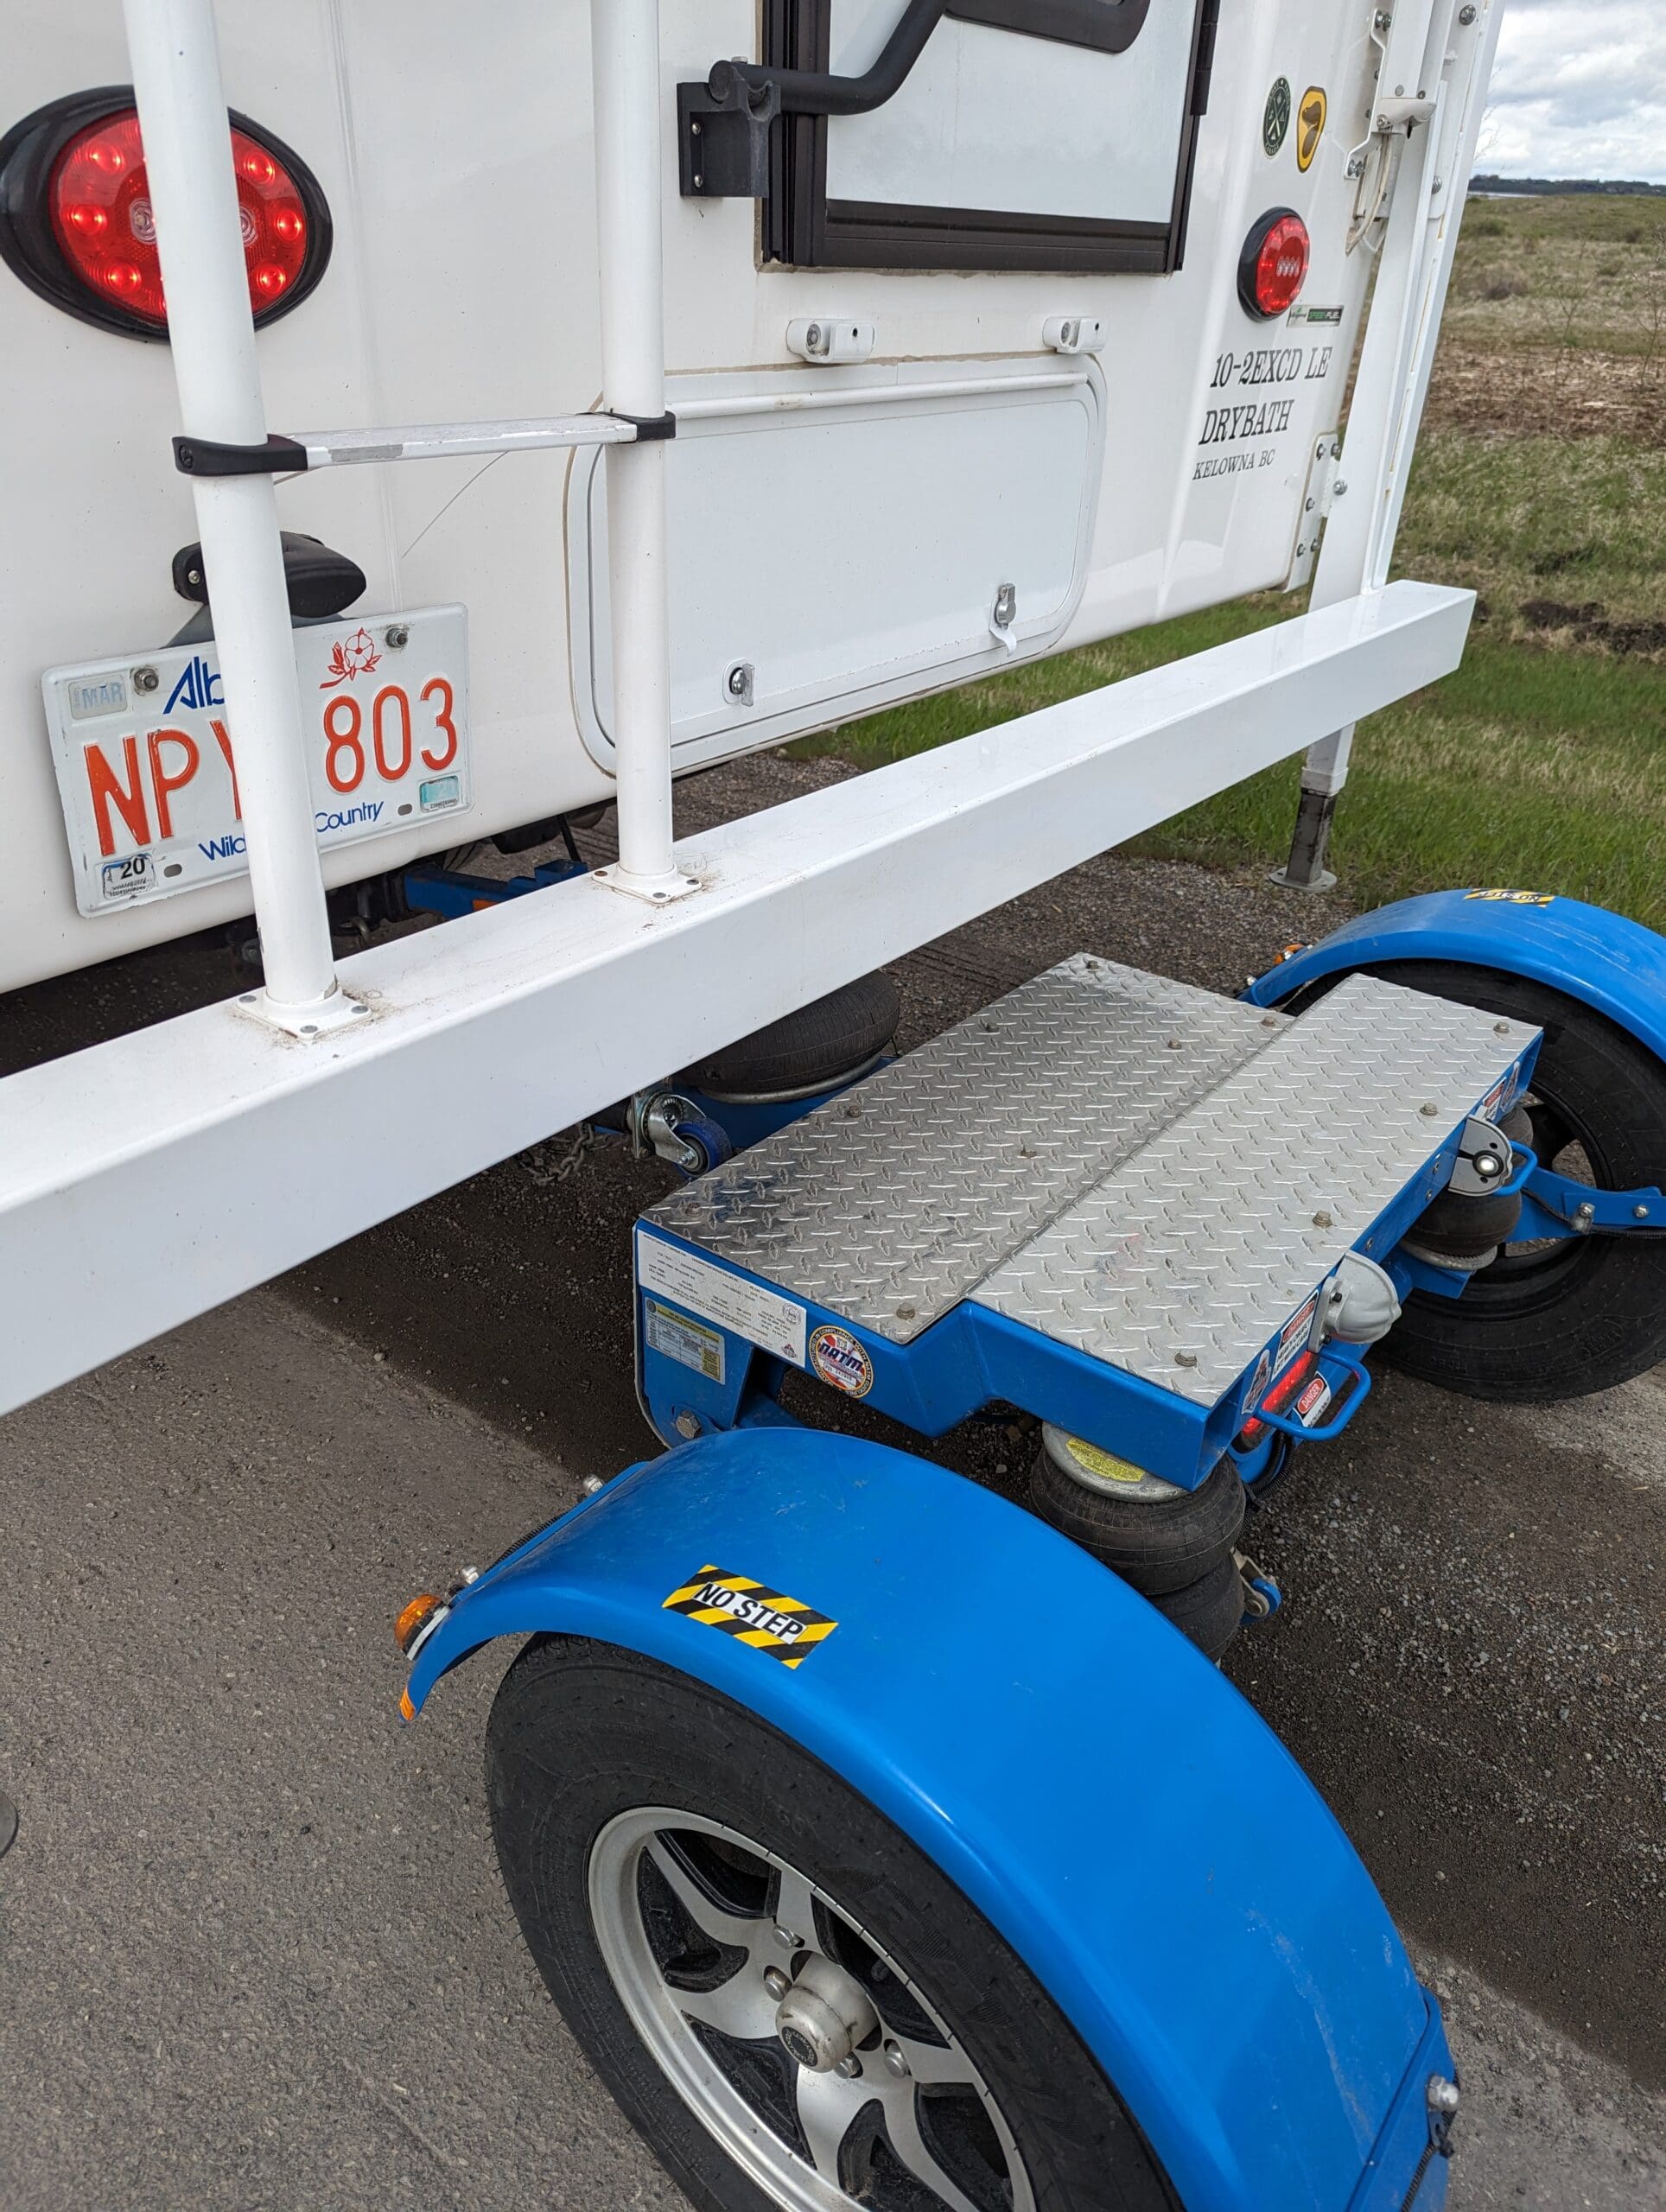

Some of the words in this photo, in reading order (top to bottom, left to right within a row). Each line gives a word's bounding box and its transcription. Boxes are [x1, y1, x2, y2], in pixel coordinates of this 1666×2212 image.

[1210, 347, 1303, 388] 10-2EXCD
[1305, 346, 1333, 379] LE
[1198, 399, 1295, 446] DRYBATH
[1192, 451, 1256, 480] KELOWNA
[1258, 448, 1276, 472] BC
[82, 682, 124, 710] MAR
[322, 677, 459, 794] 803
[315, 800, 385, 834] Country
[120, 856, 146, 880] 20
[818, 1343, 863, 1372] NATM
[1301, 1382, 1322, 1408] DANGER
[694, 1583, 736, 1608] NO
[734, 1599, 805, 1640] STEP
